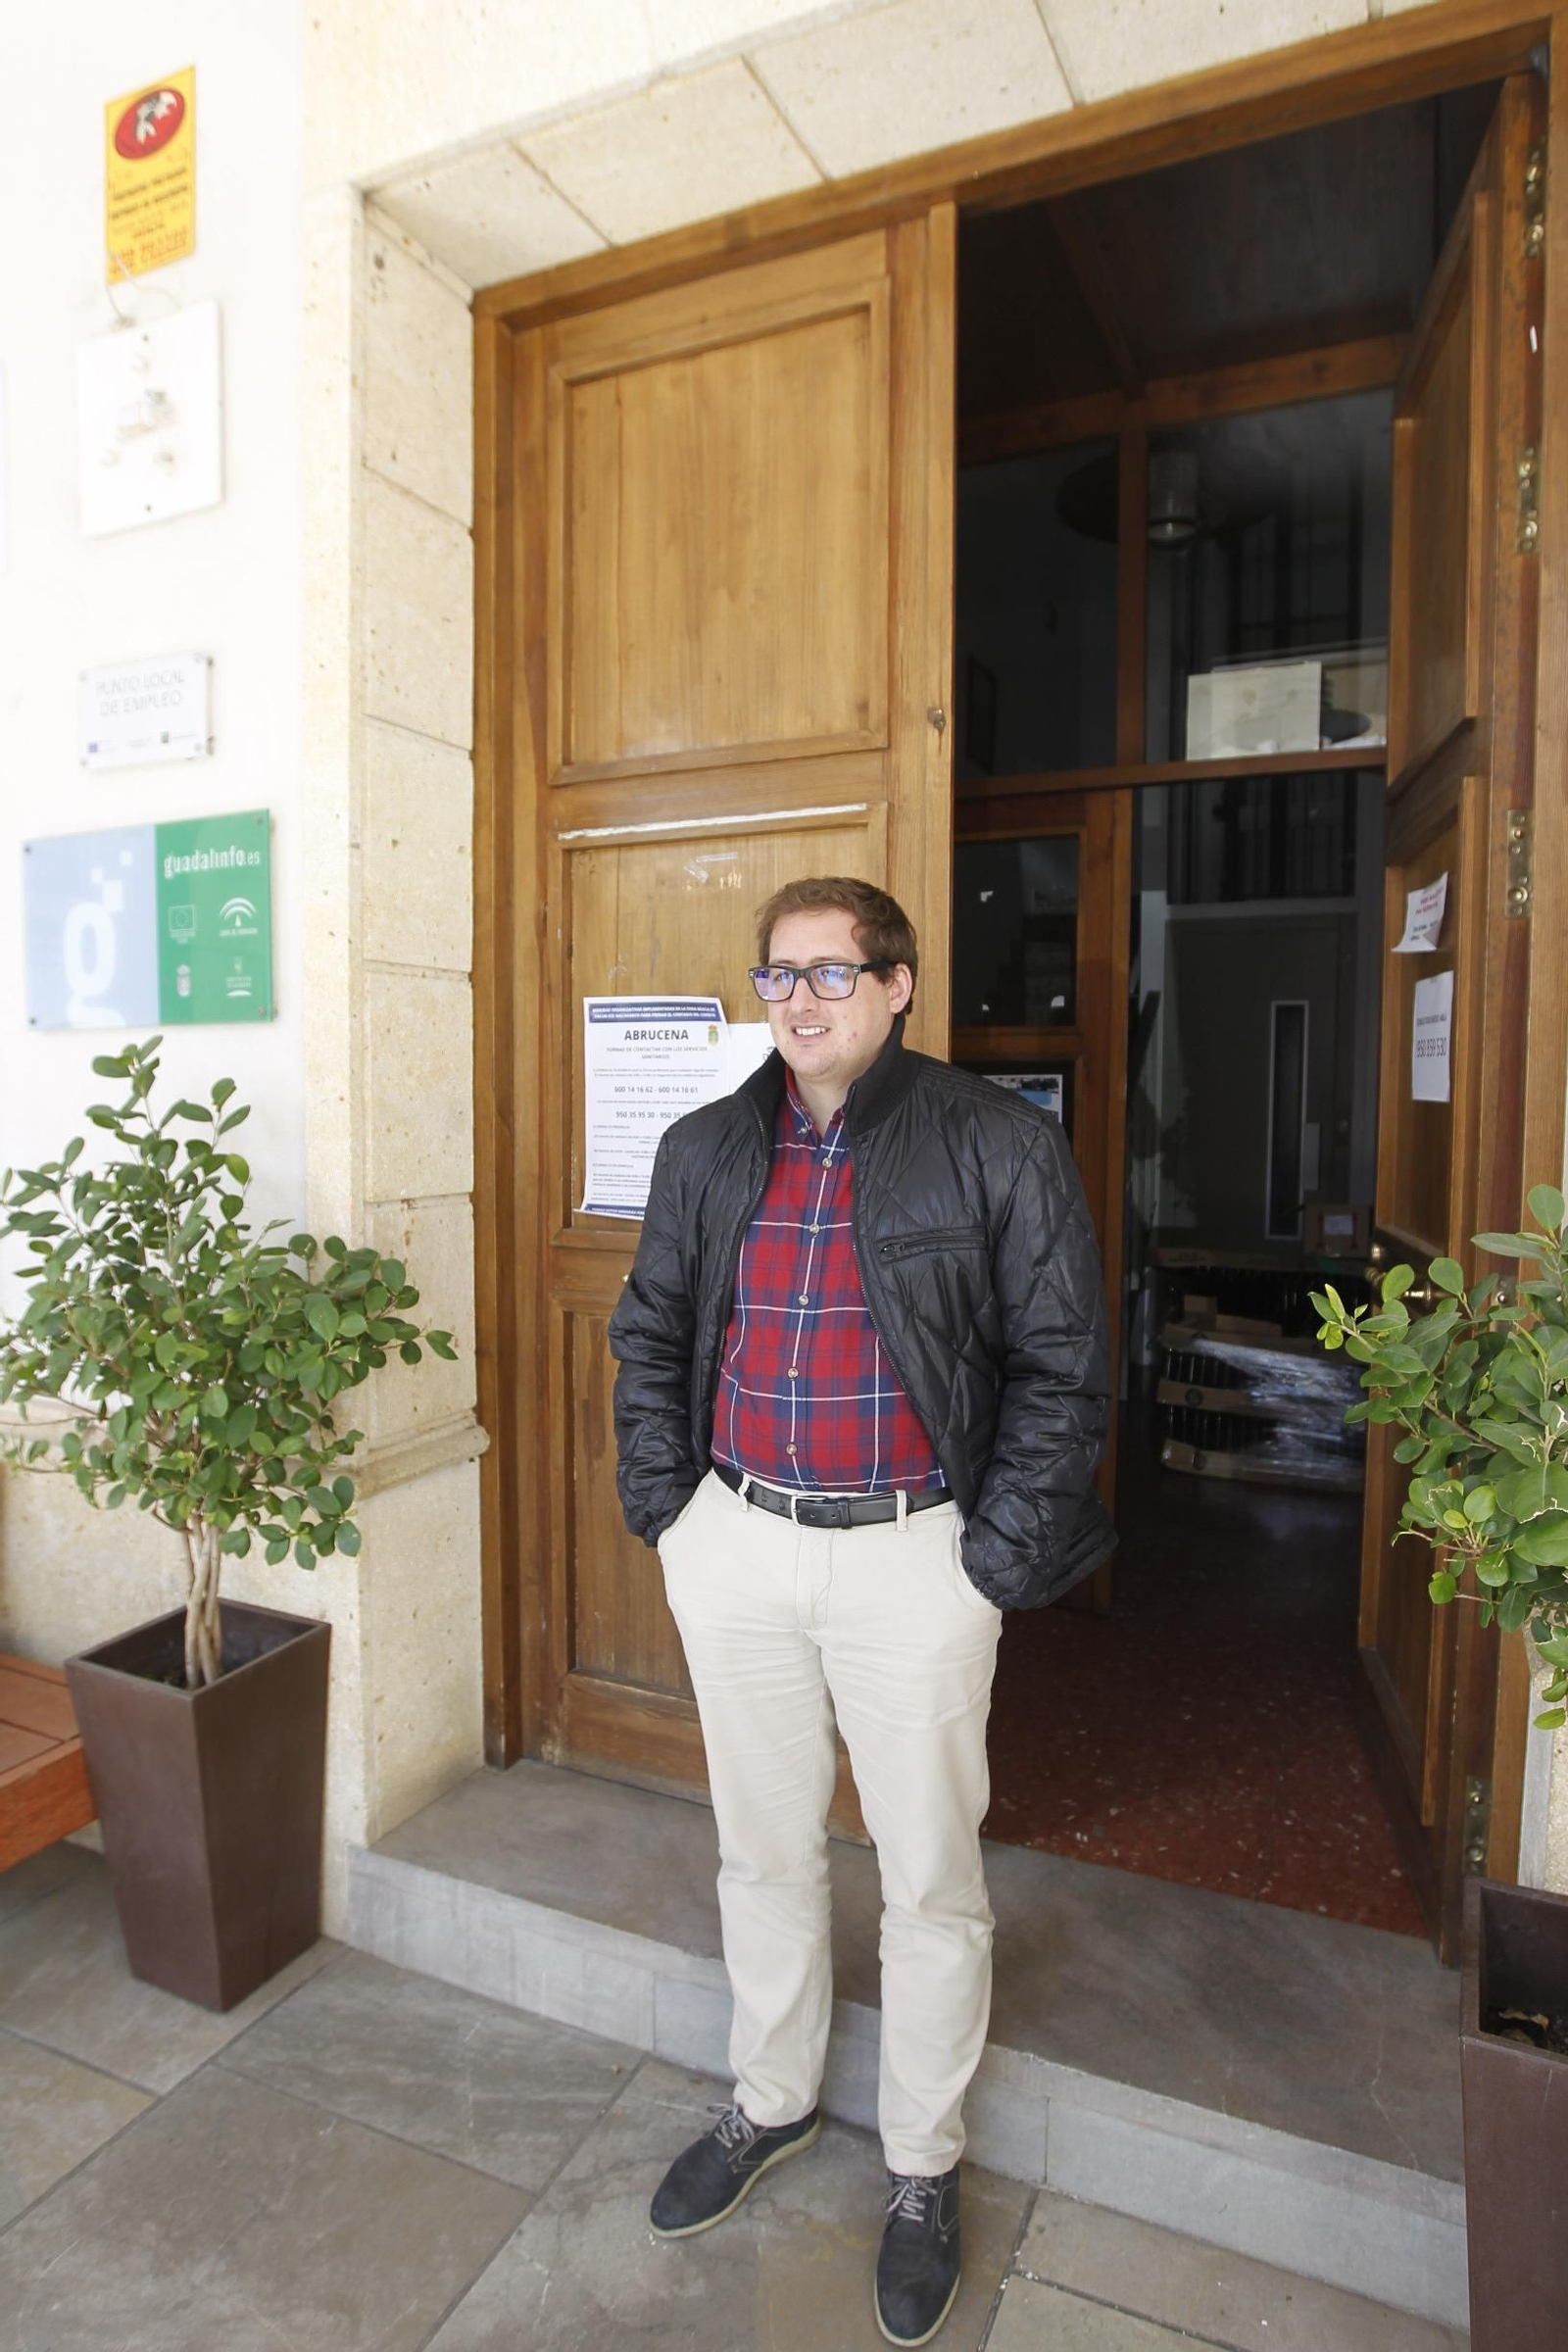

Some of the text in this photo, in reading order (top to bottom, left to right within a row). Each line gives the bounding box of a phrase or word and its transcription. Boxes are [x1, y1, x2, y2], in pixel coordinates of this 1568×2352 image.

[97, 668, 185, 696] PUNTO LOCAL
[99, 690, 182, 716] DE EMPLEO
[624, 1029, 689, 1041] ABRUCENA
